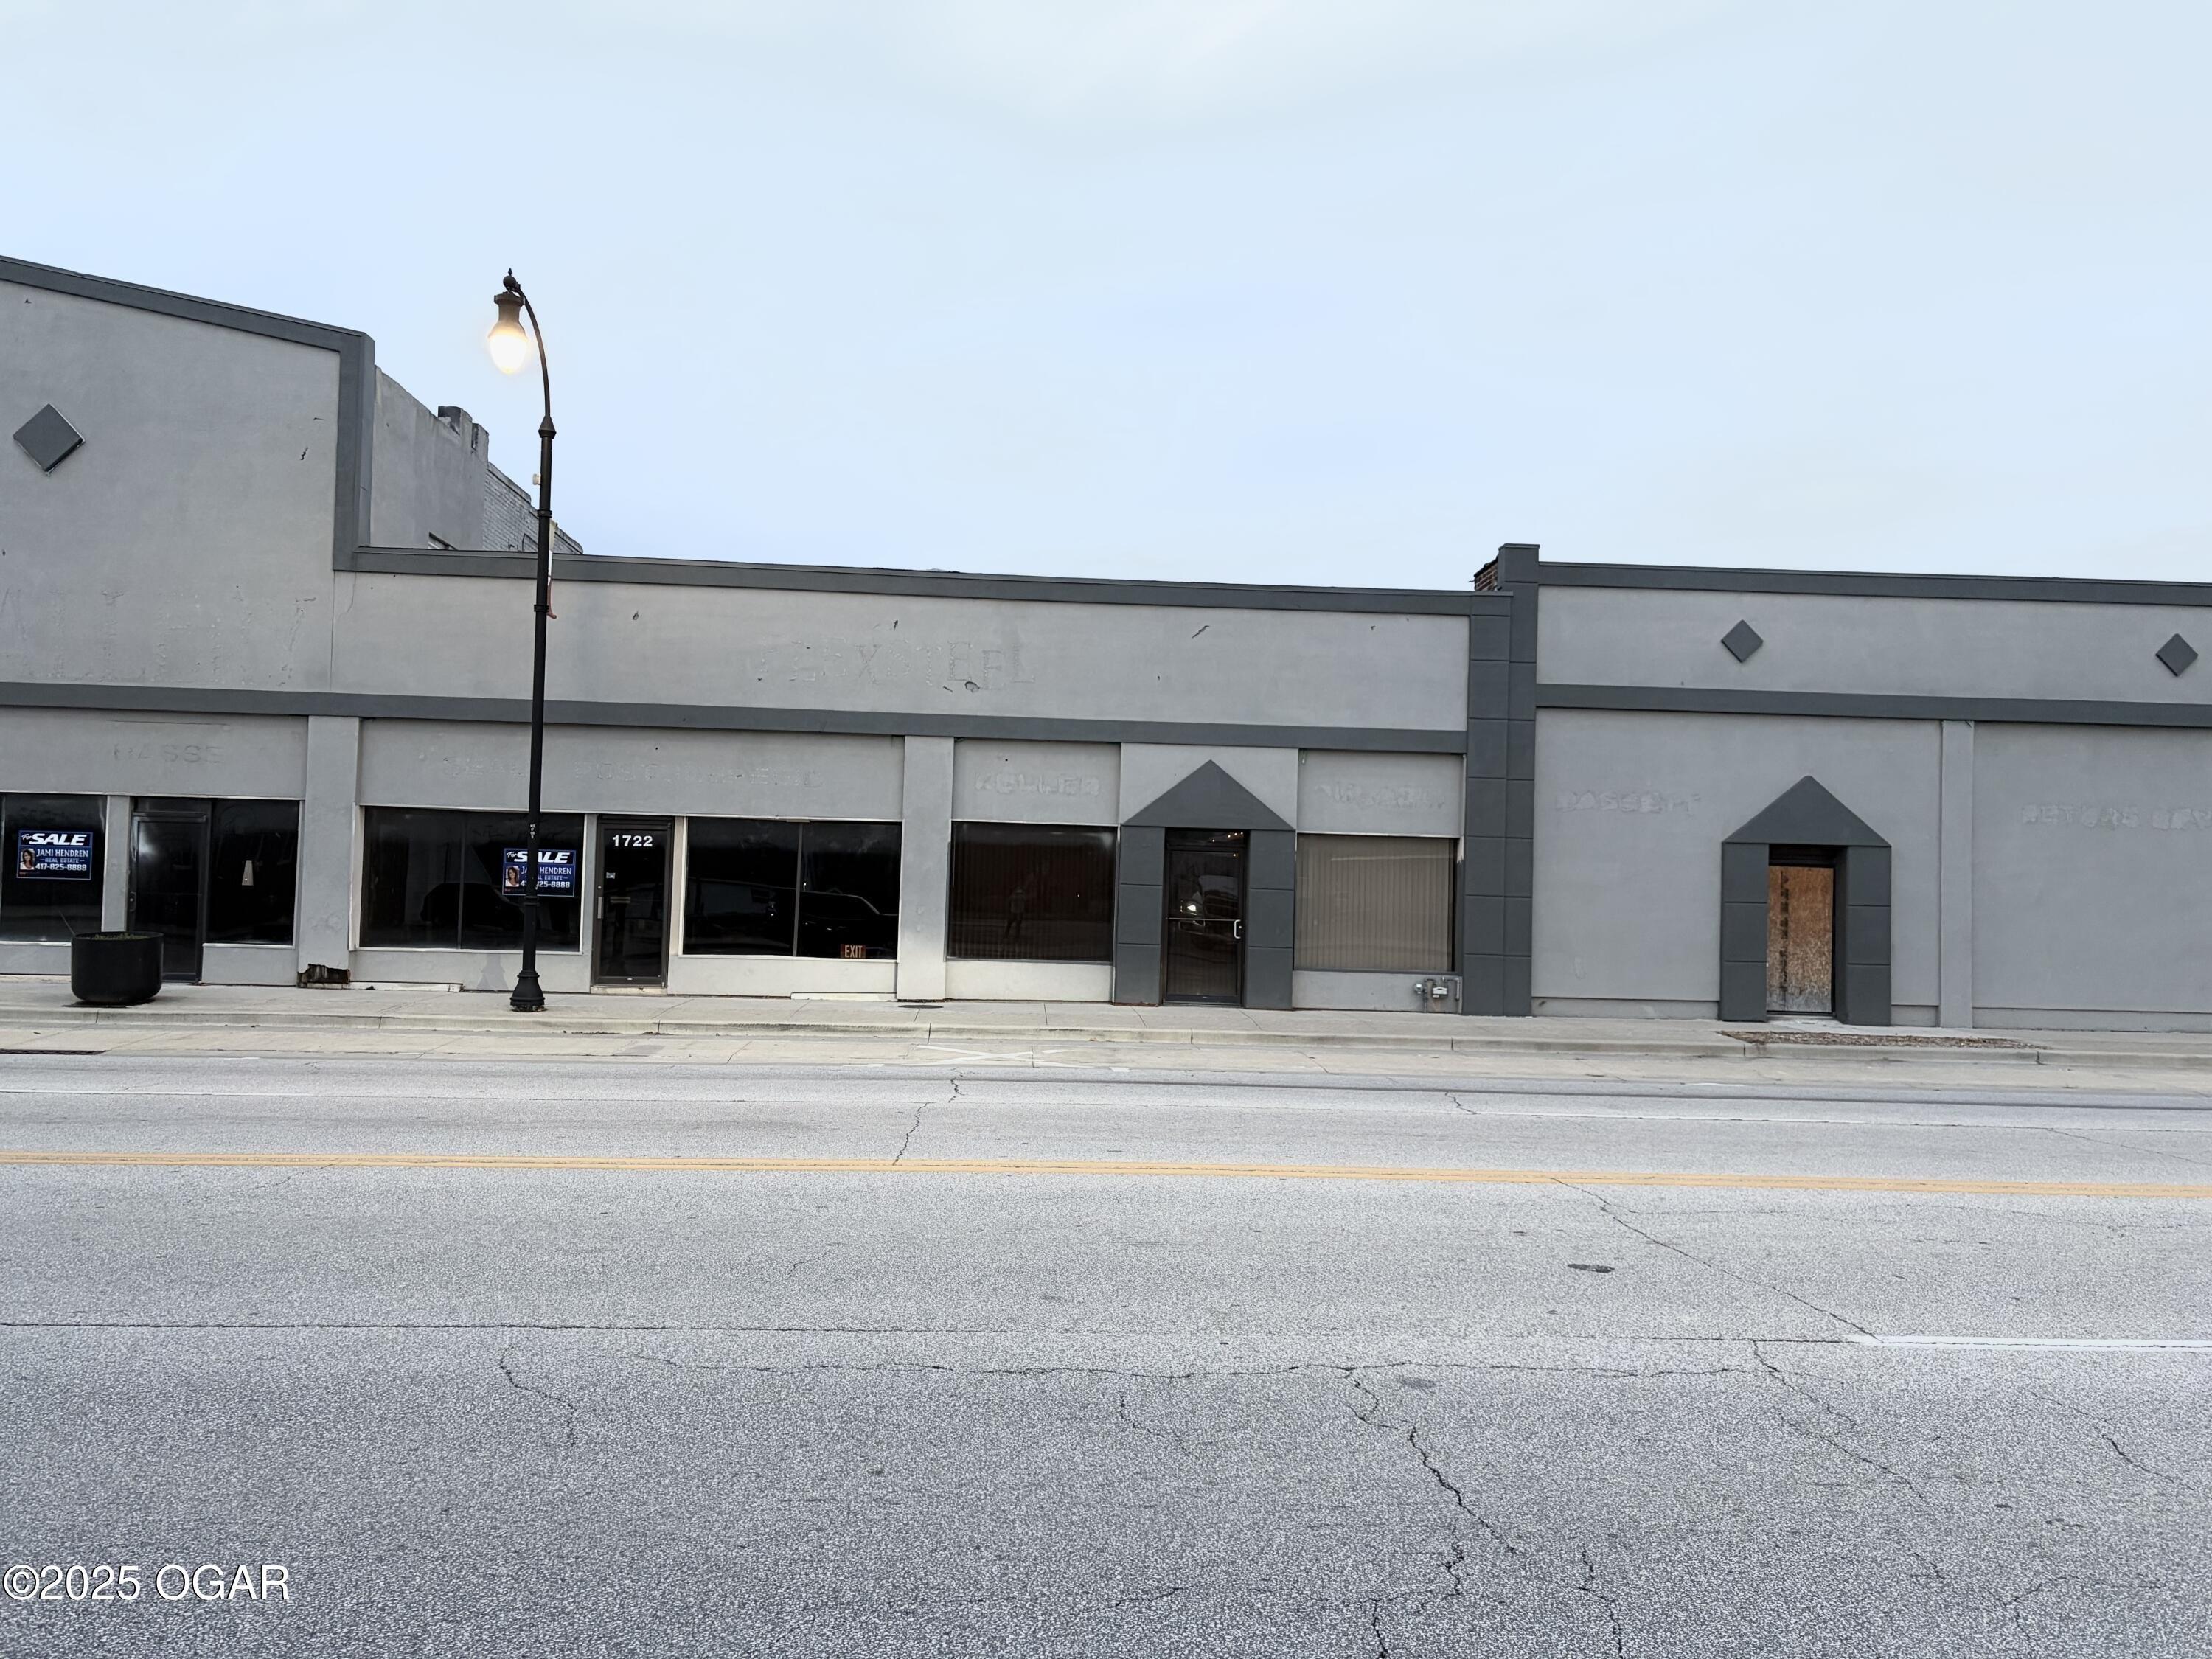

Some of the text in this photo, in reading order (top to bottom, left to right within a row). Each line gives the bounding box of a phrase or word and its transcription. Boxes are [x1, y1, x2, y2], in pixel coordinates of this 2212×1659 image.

[29, 833, 87, 846] SALE
[612, 835, 653, 847] 1722
[36, 849, 88, 858] JAMI HENDREN
[539, 866, 571, 875] HENDREN
[844, 945, 863, 959] EXIT
